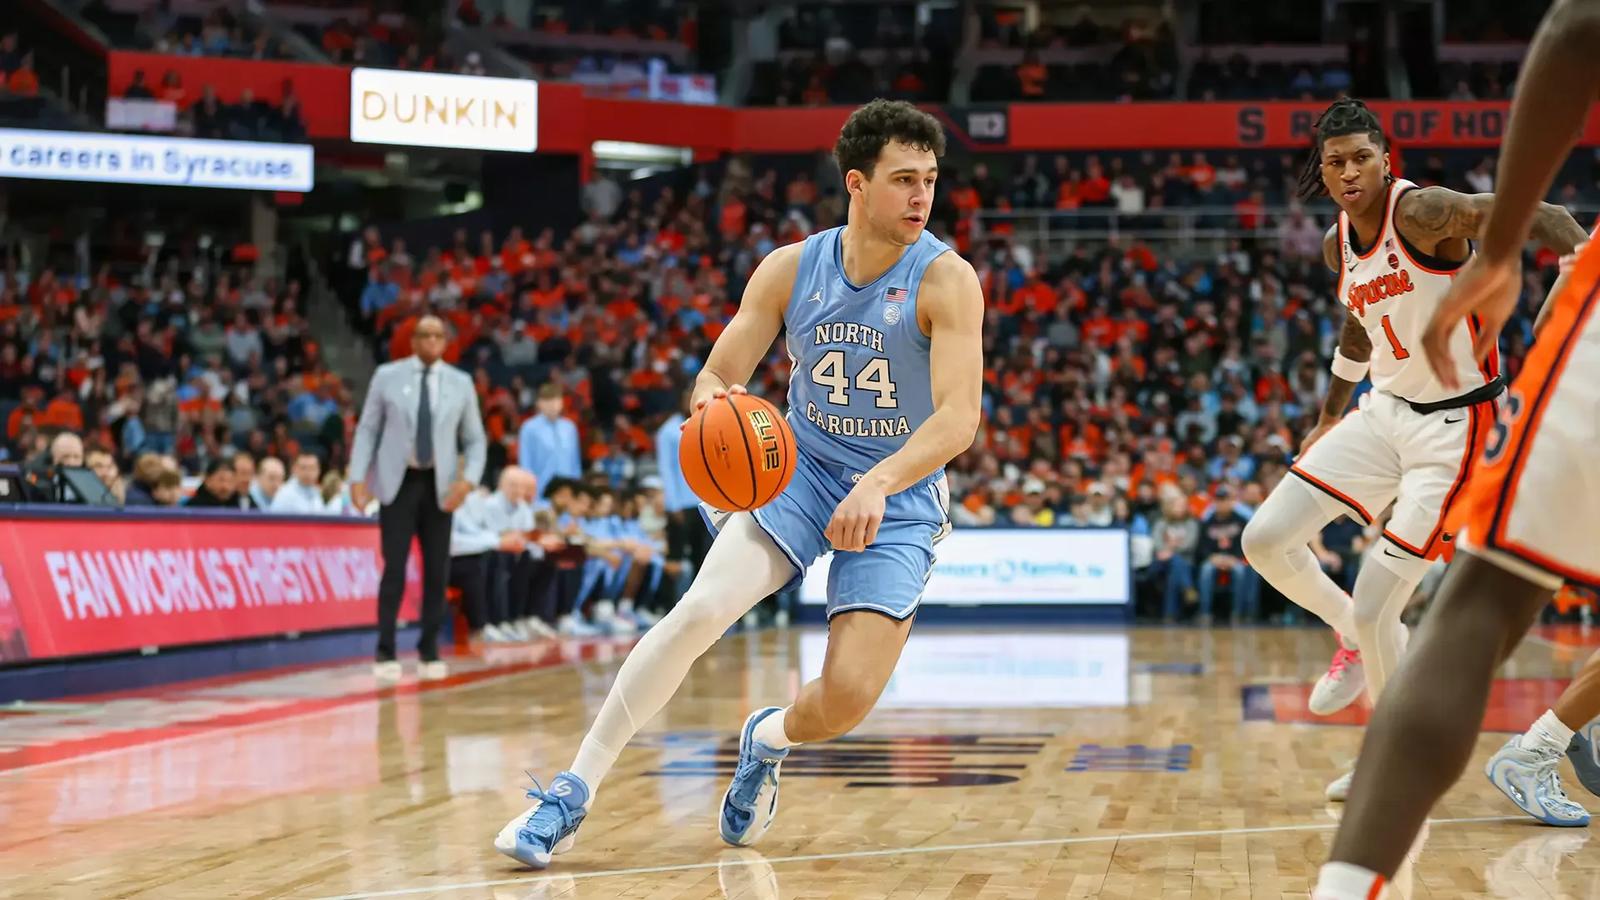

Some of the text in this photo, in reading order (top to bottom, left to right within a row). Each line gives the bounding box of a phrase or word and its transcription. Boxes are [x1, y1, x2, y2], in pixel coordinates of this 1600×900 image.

[1393, 110, 1440, 139] OF
[1453, 109, 1511, 139] HO
[10, 144, 121, 172] careers
[130, 146, 154, 170] in
[1347, 269, 1415, 318] Syracuse
[814, 322, 884, 353] NORTH
[1381, 314, 1410, 361] 1
[811, 350, 898, 408] 44
[751, 409, 780, 471] ELITE
[806, 401, 911, 437] CAROLINA
[45, 551, 122, 620] FAN
[107, 549, 213, 615] WORK
[198, 549, 236, 610] IS
